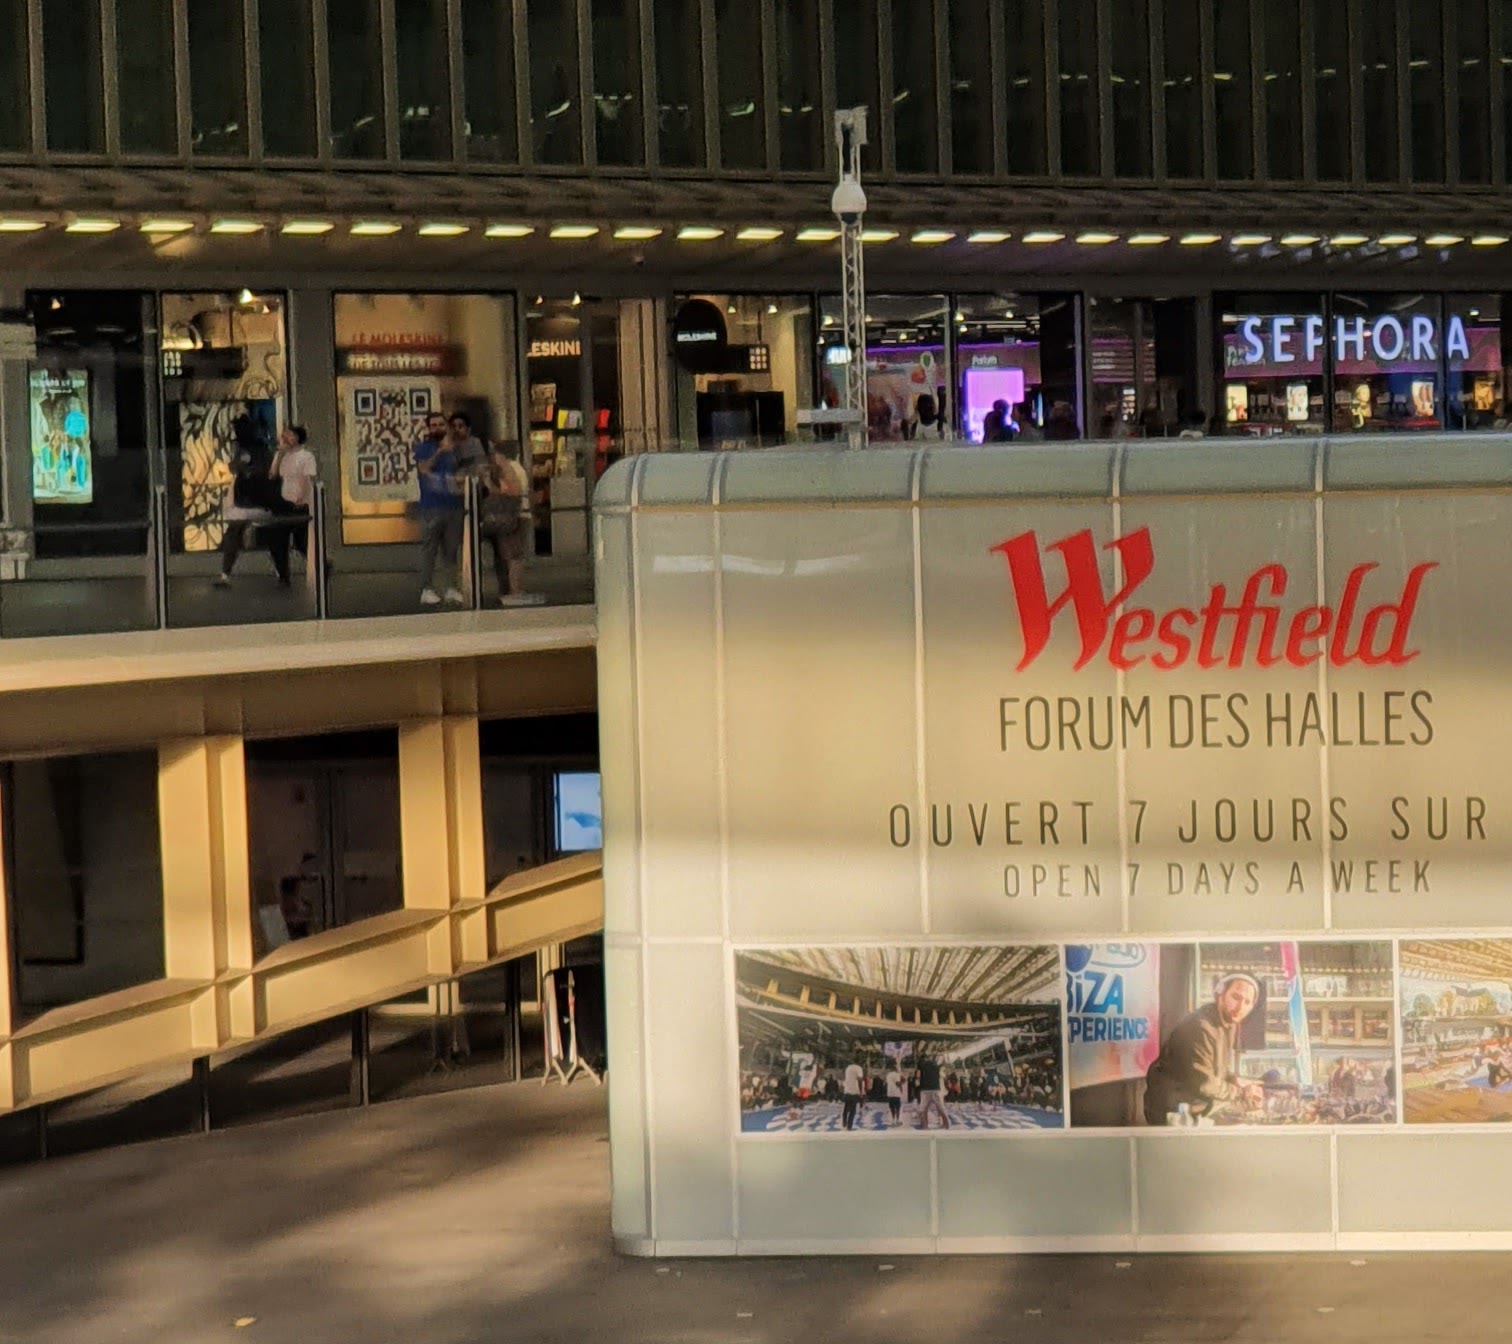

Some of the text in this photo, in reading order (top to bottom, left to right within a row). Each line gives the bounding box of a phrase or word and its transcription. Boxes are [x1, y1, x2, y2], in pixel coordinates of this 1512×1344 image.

[1243, 314, 1470, 362] SEPHORA
[989, 526, 1440, 673] Westfield
[999, 690, 1434, 752] FORUM DES HALLES
[889, 801, 1094, 848] OUVERT
[1128, 799, 1147, 845] 7
[1178, 797, 1348, 844] JOURS
[1391, 796, 1487, 841] SUR
[1003, 860, 1431, 898] OPEN 7 DAYS A WEEK
